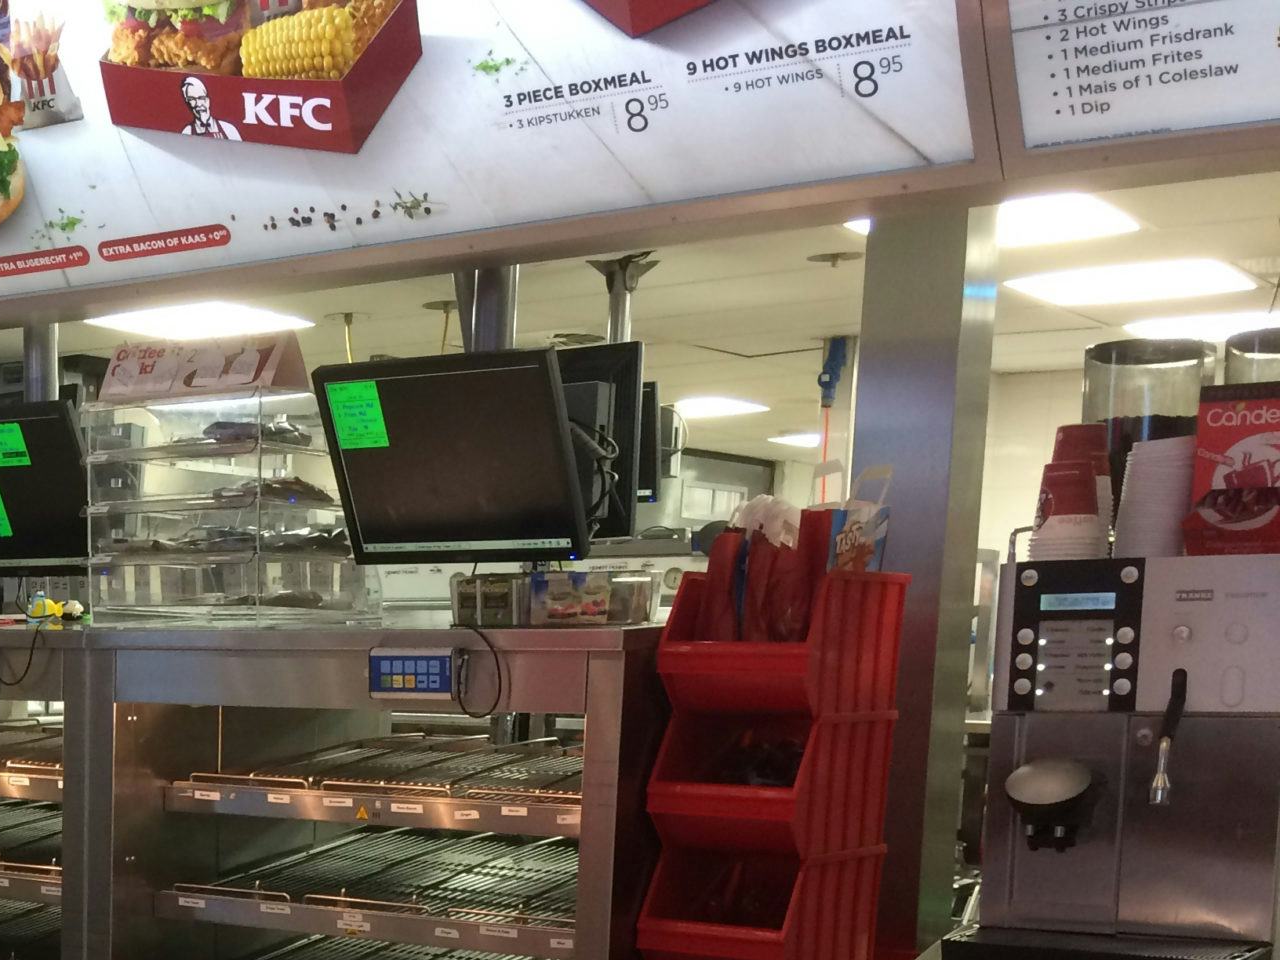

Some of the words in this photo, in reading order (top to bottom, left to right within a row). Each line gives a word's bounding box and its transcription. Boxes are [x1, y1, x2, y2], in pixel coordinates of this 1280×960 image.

[1057, 8, 1069, 21] 3
[1073, 0, 1128, 20] Crispy
[1060, 29, 1069, 42] 2
[1076, 24, 1107, 40] Hot
[1113, 14, 1169, 33] Wings
[1061, 48, 1068, 61] 1
[1074, 39, 1143, 59] Medium
[1150, 22, 1235, 47] Frisdrank
[686, 61, 697, 76] 9
[702, 54, 740, 73] HOT
[744, 41, 810, 65] WINGS
[814, 25, 911, 54] BOXMEAL
[1064, 67, 1070, 80] 1
[1076, 58, 1146, 78] Medium
[1151, 48, 1203, 66] Frites
[503, 94, 513, 108] 3
[517, 85, 564, 105] PIECE
[567, 70, 651, 97] BOXMEAL
[733, 81, 741, 92] 9
[745, 76, 772, 91] HOT
[777, 68, 824, 86] WINGS
[1066, 86, 1073, 98] 1
[1079, 79, 1117, 97] Mais
[1123, 75, 1141, 90] of
[1146, 74, 1153, 86] 1
[1158, 62, 1239, 85] Coleslaw
[32, 98, 55, 112] KFC
[242, 92, 333, 131] KFC
[517, 118, 524, 129] 3
[526, 106, 601, 128] KIPSTUKKEN
[1069, 104, 1075, 116] 1
[1081, 100, 1111, 115] Dip
[102, 245, 132, 257] EXTRA
[132, 241, 165, 253] BACON
[166, 237, 179, 247] OF
[180, 234, 207, 245] KAAS
